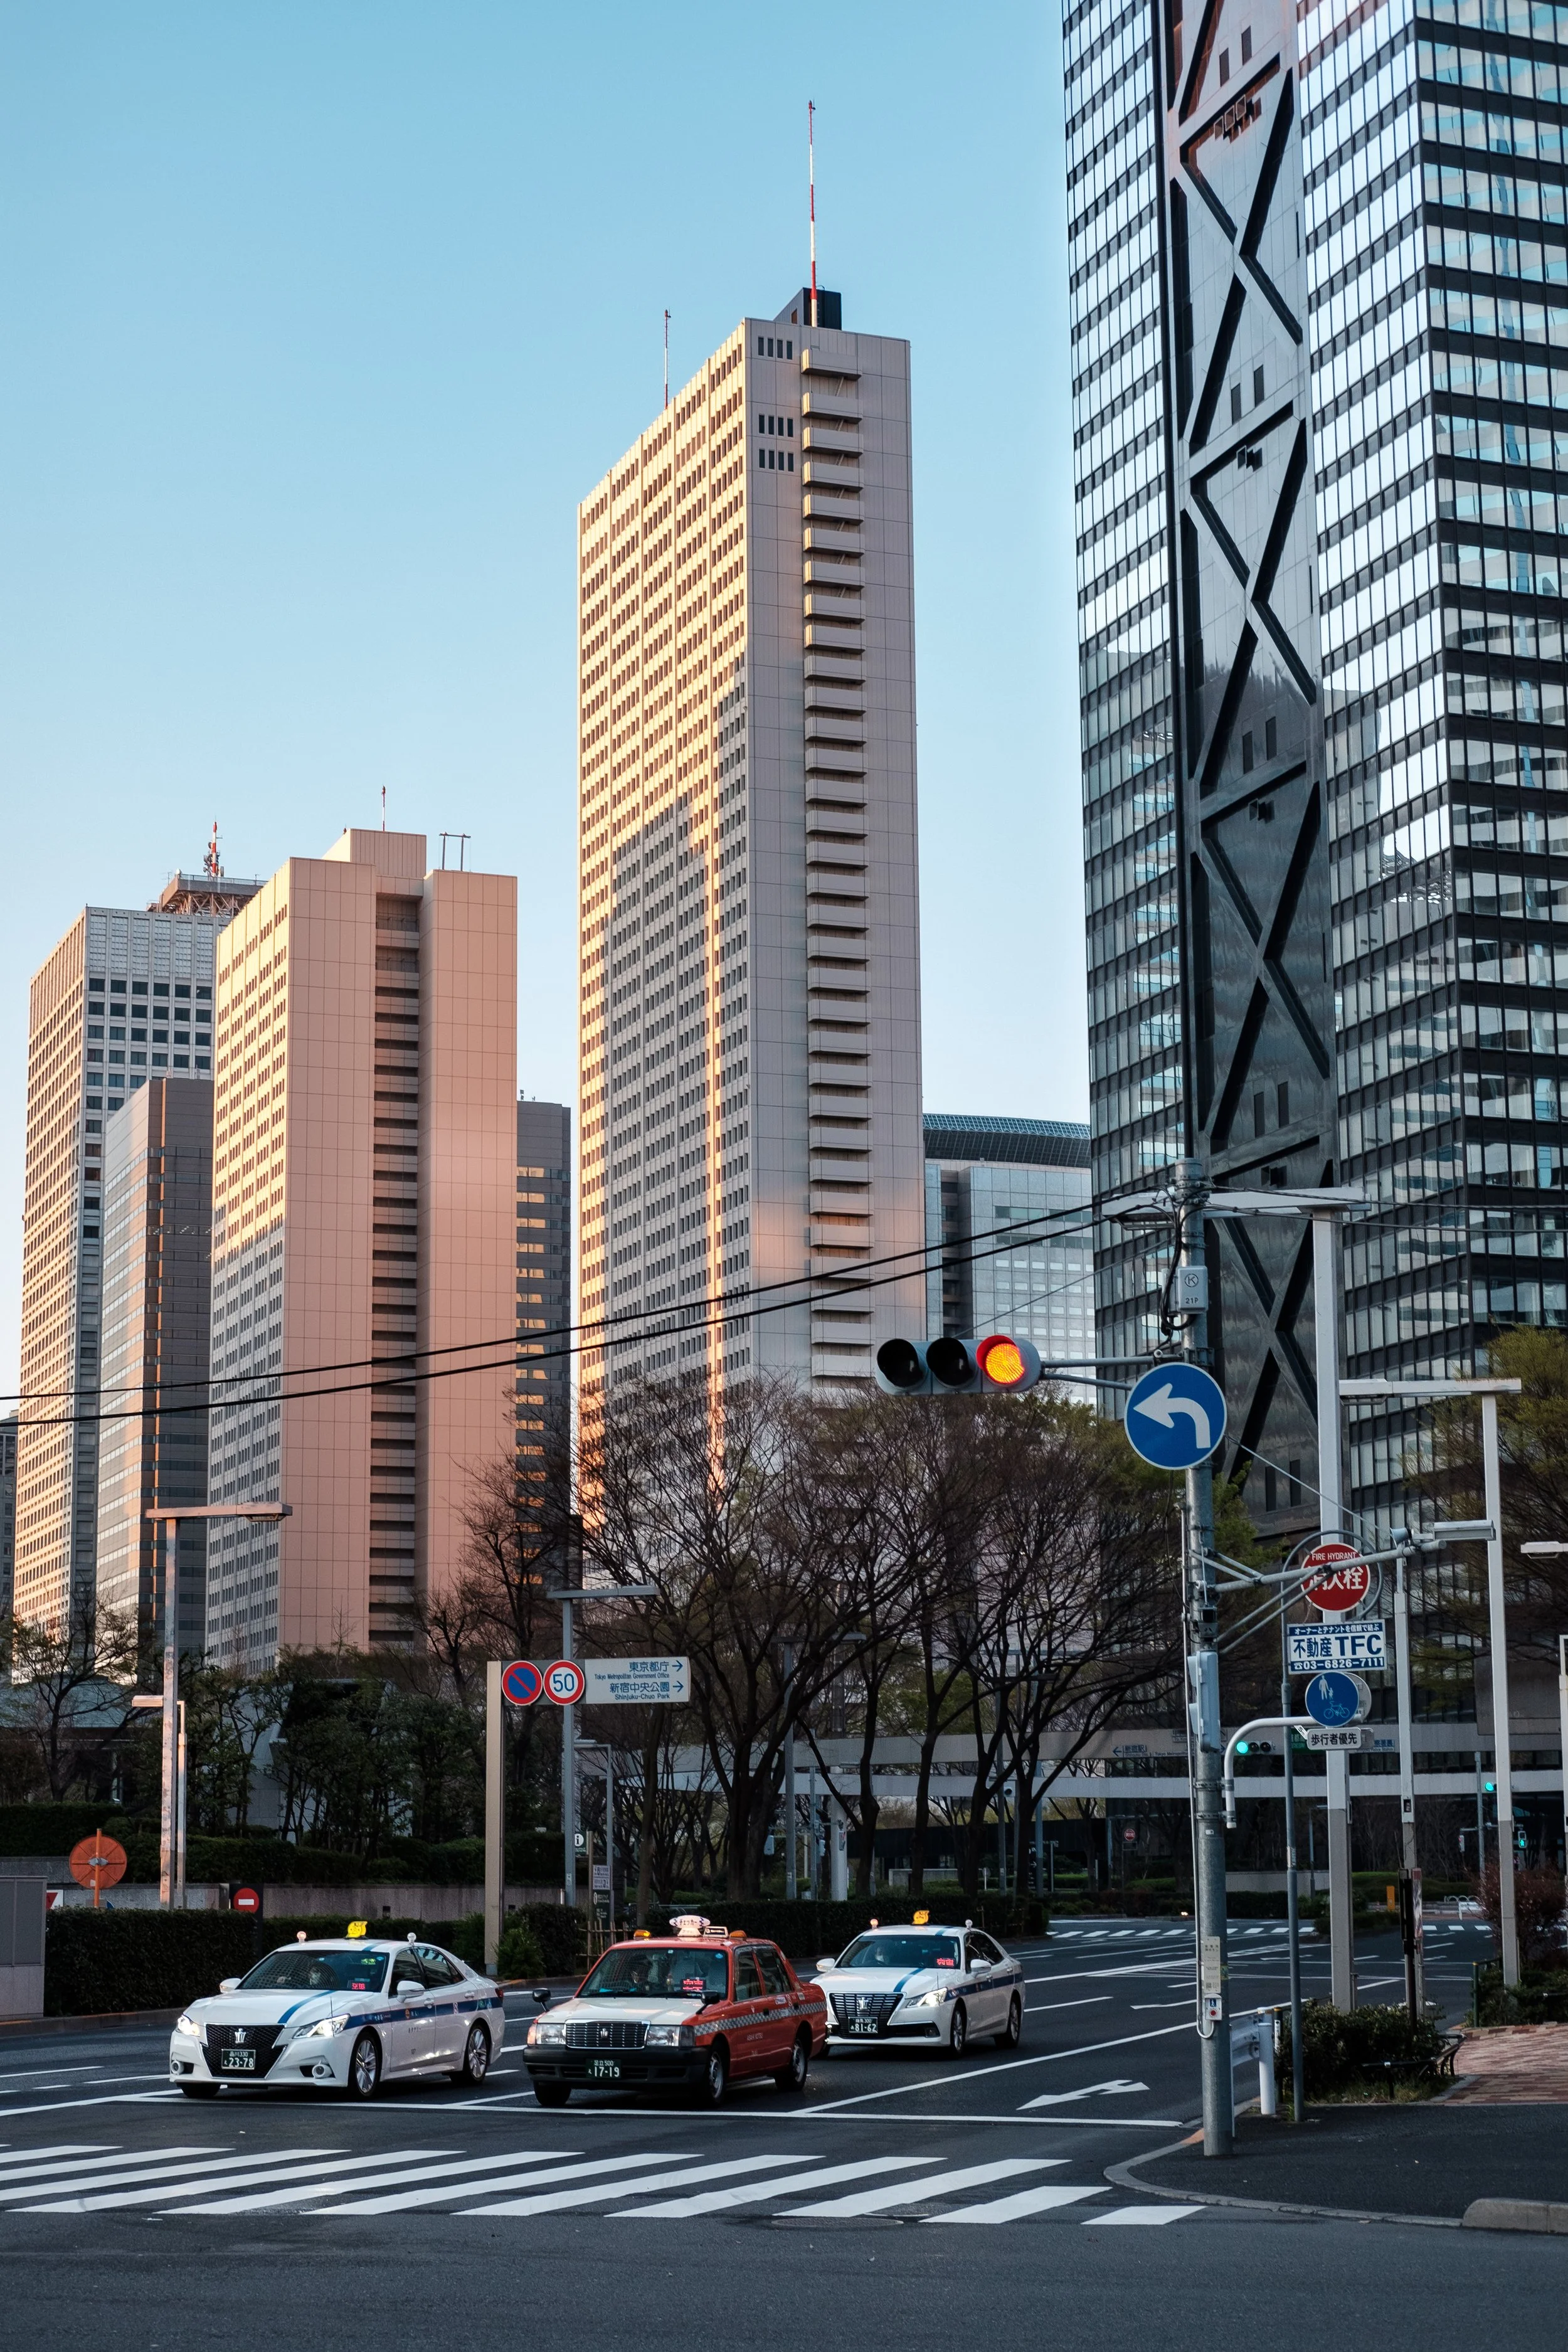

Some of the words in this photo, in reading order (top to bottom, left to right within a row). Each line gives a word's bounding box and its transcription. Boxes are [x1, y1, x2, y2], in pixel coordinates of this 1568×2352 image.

[1311, 1552, 1326, 1561] FIRE
[1327, 1551, 1357, 1560] HYDRANT
[1293, 1636, 1333, 1659] 不動産
[1335, 1634, 1382, 1656] TFC
[629, 1661, 669, 1672] 東京都庁
[1303, 1658, 1384, 1670] 03-6826-7111
[553, 1673, 575, 1693] 50
[610, 1682, 669, 1693] 新宿中央公園
[1311, 1732, 1357, 1746] 歩行者優先
[855, 2023, 877, 2032] 81-62
[229, 2057, 254, 2068] 23-78
[595, 2067, 620, 2077] 17-19
